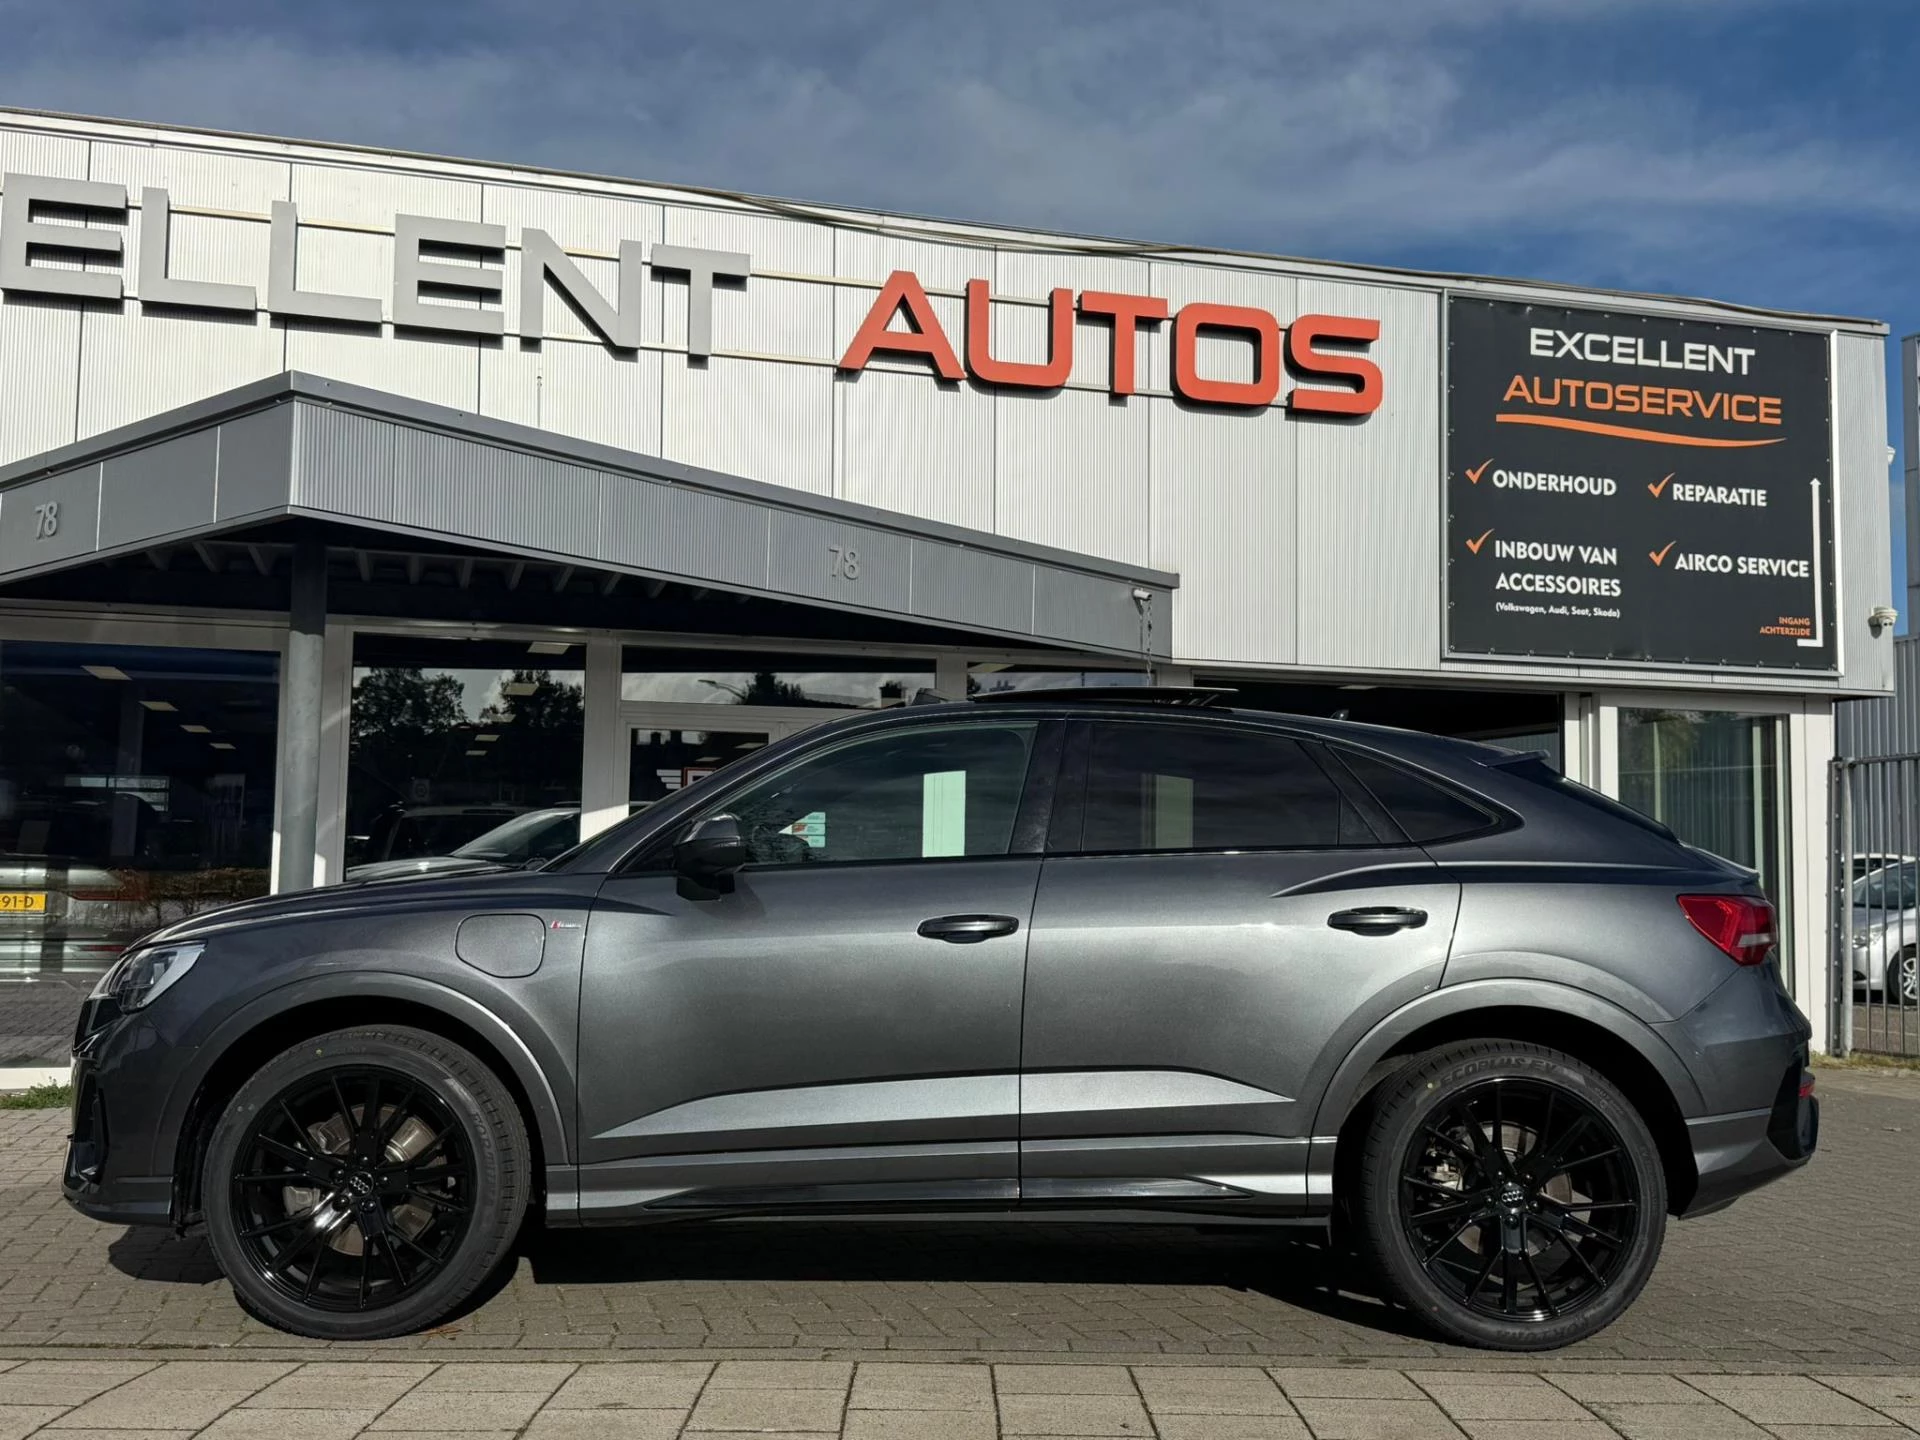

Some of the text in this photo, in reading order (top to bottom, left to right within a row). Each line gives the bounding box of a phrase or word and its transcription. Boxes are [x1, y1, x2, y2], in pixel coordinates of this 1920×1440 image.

[0, 172, 1384, 415] ELLENT AUTOS
[1529, 327, 1756, 376] EXCELLENT
[1503, 374, 1782, 425] AUTOSERVICE
[1492, 469, 1617, 496] ONDERHOUD
[1672, 482, 1768, 507] REPARATIE
[34, 500, 58, 540] 78
[827, 545, 860, 580] 78
[1495, 540, 1617, 566] INBOUW VAN
[1675, 552, 1810, 578] AIRCO SERVICE
[1495, 572, 1622, 597] ACCESSOIRES
[1548, 605, 1570, 616] Audi,
[1779, 616, 1811, 626] INGANG
[1760, 626, 1811, 637] ACHTERZIJDE
[0, 895, 35, 909] 91-D
